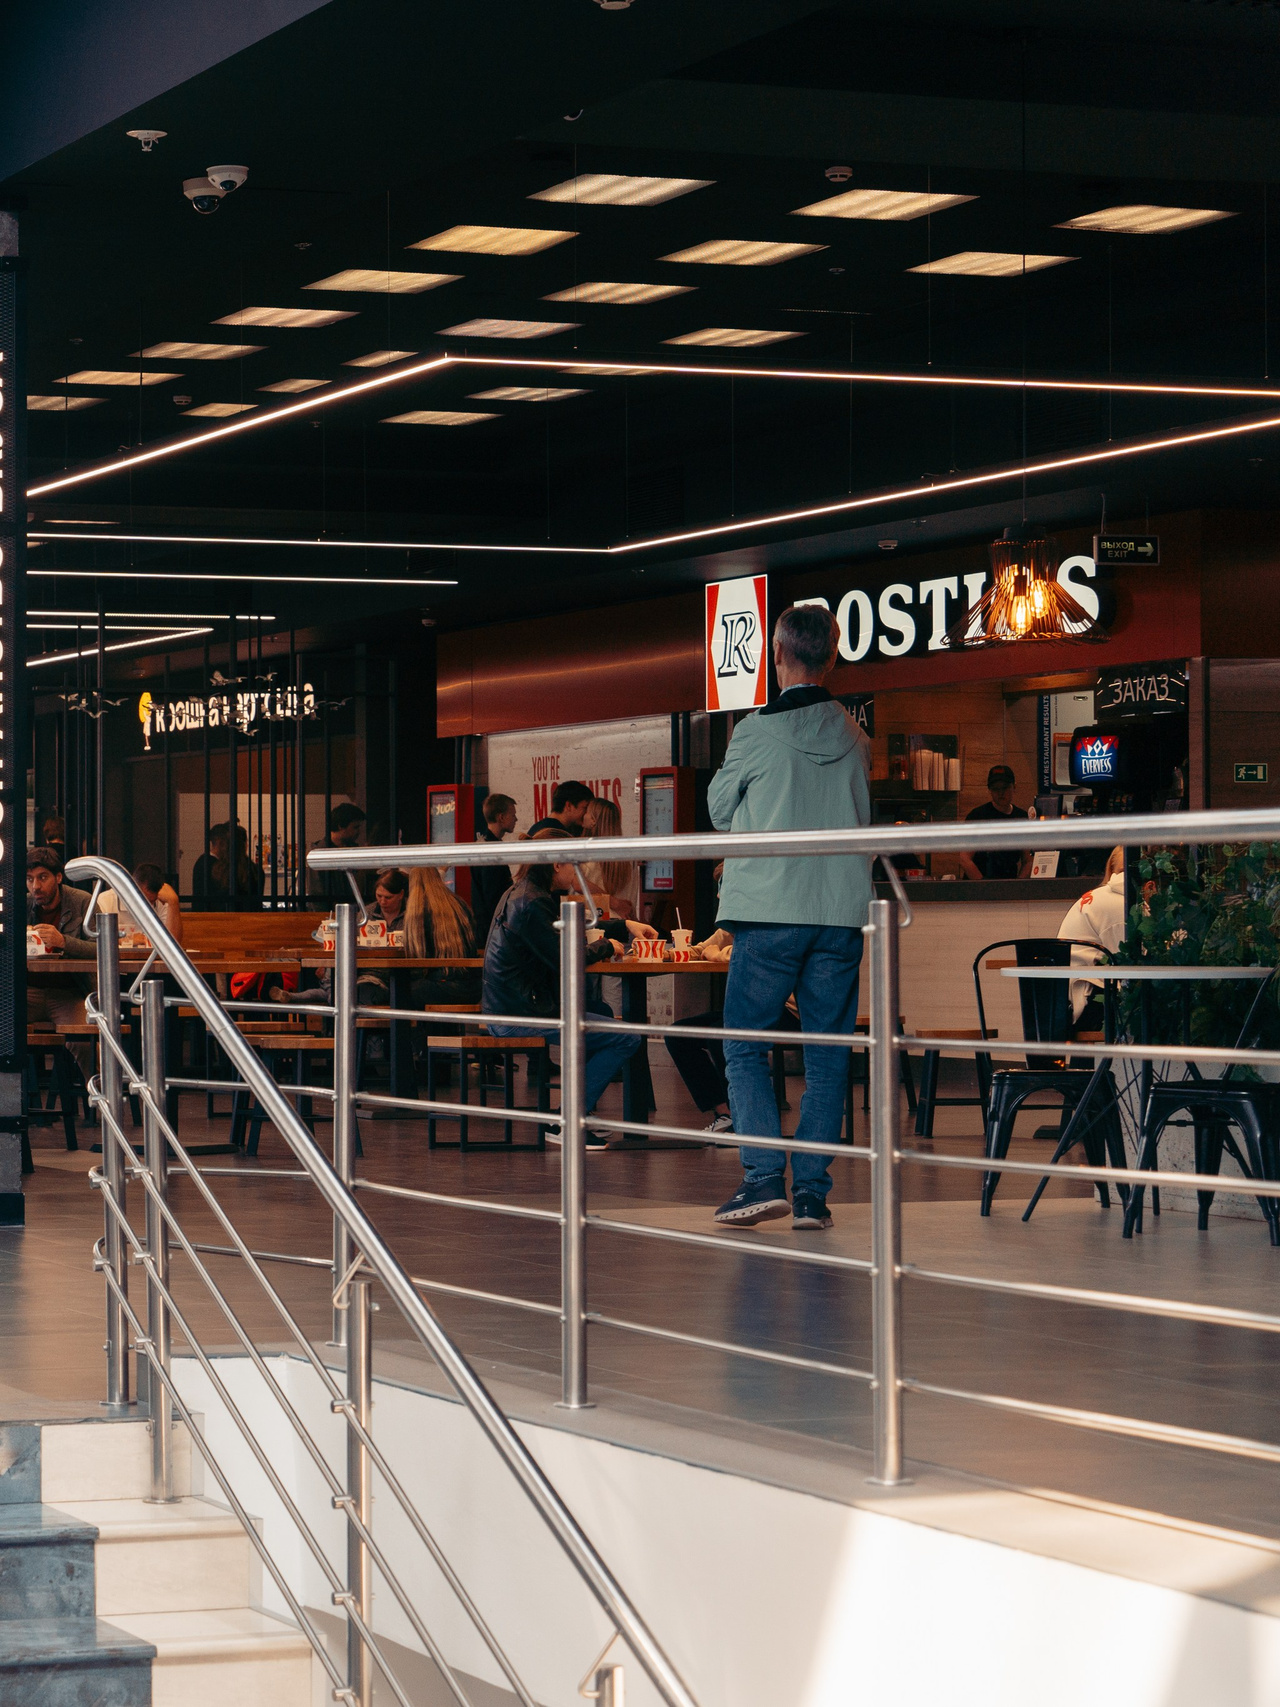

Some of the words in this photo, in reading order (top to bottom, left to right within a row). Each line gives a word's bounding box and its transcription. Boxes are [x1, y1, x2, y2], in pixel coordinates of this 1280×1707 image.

[1101, 541, 1135, 551] ВЫХОД
[1107, 550, 1128, 558] EXIT
[793, 555, 1099, 662] OSTIS
[717, 610, 756, 678] R
[1112, 673, 1169, 704] ЗАКАЗ
[531, 754, 560, 782] YOU'RE
[1081, 757, 1112, 774] EVERVESS
[1043, 774, 1050, 787] MY
[533, 777, 622, 825] MNTS
